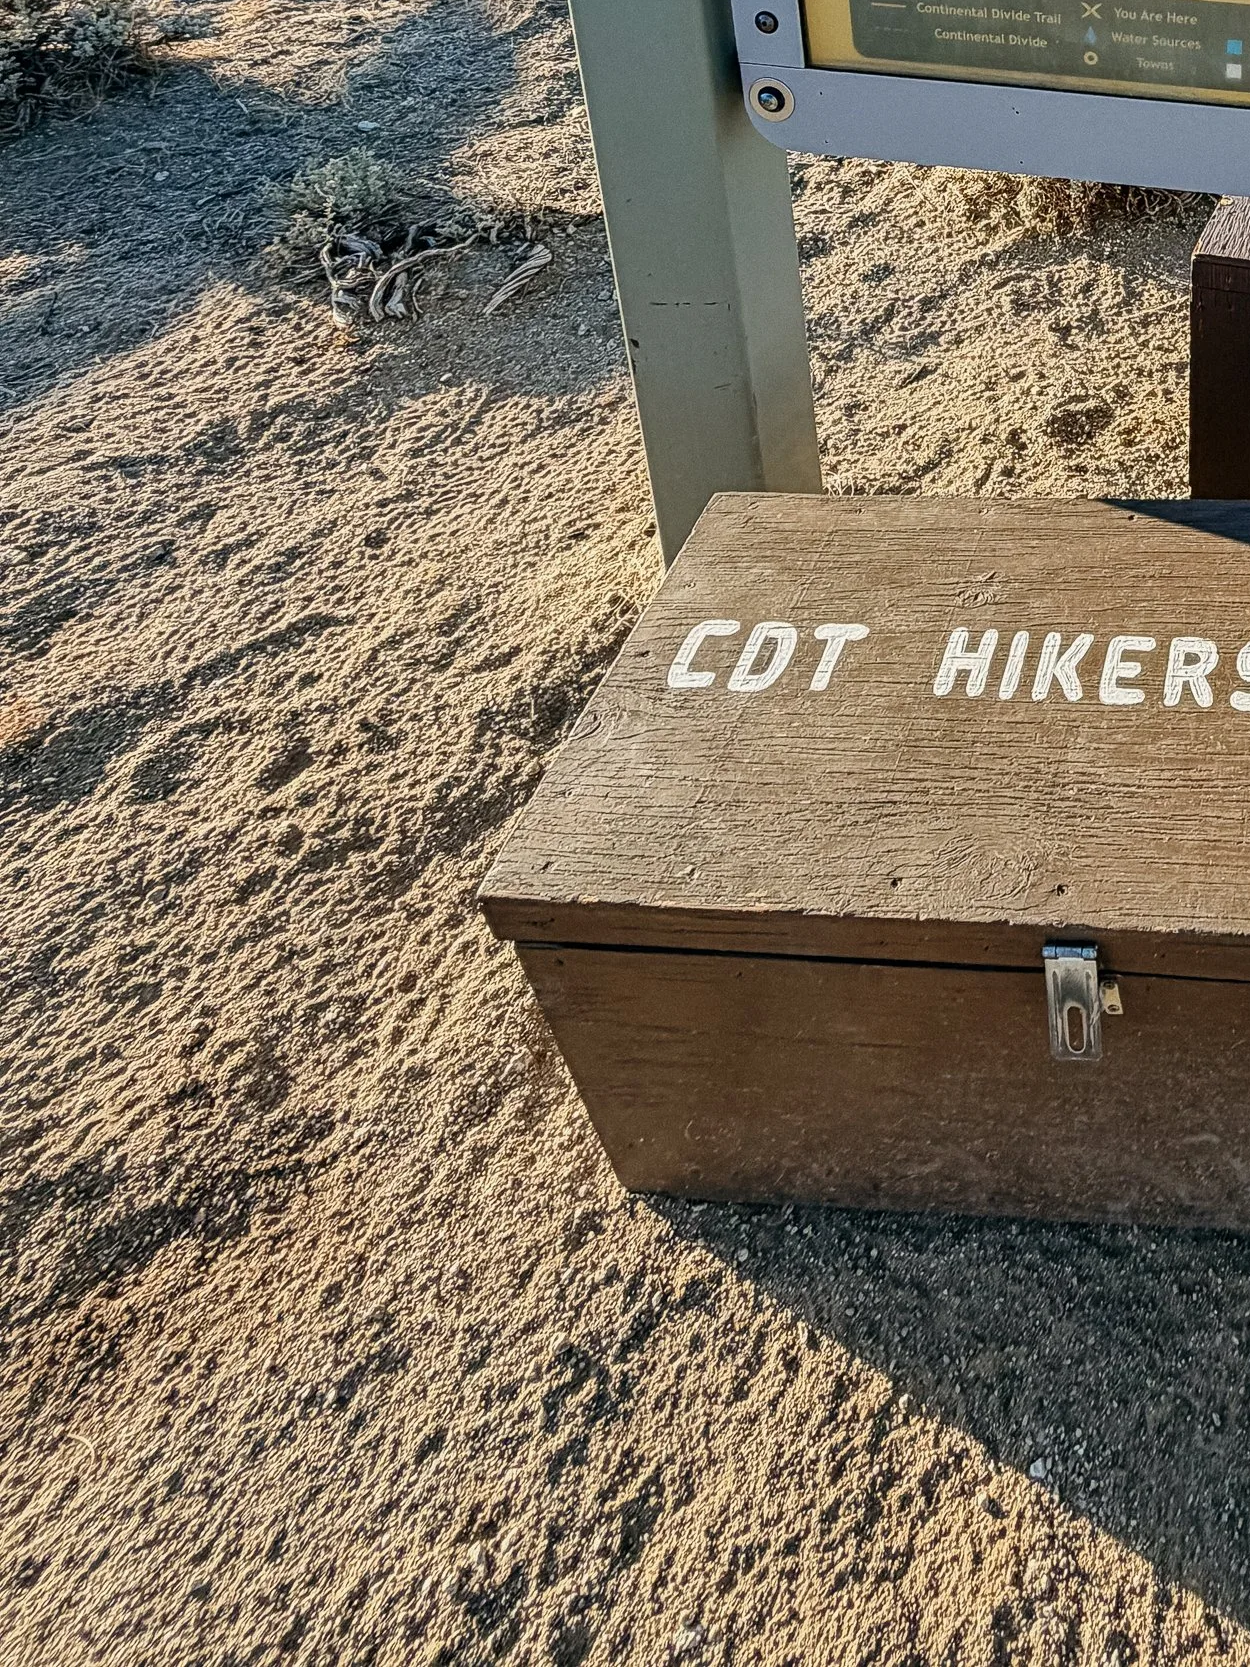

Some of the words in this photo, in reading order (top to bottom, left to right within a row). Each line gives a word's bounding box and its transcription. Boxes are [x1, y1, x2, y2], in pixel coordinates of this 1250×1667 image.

[916, 2, 988, 18] Continental
[992, 7, 1031, 22] Divide
[1034, 11, 1061, 25] Trail
[1114, 8, 1137, 21] You
[1141, 11, 1163, 23] Are
[1167, 12, 1198, 25] Here
[934, 29, 1005, 44] Continental
[1009, 34, 1048, 48] Divide
[1112, 32, 1148, 46] Water
[1152, 34, 1201, 50] Sources
[1136, 57, 1174, 71] Towns
[667, 619, 870, 693] CDT
